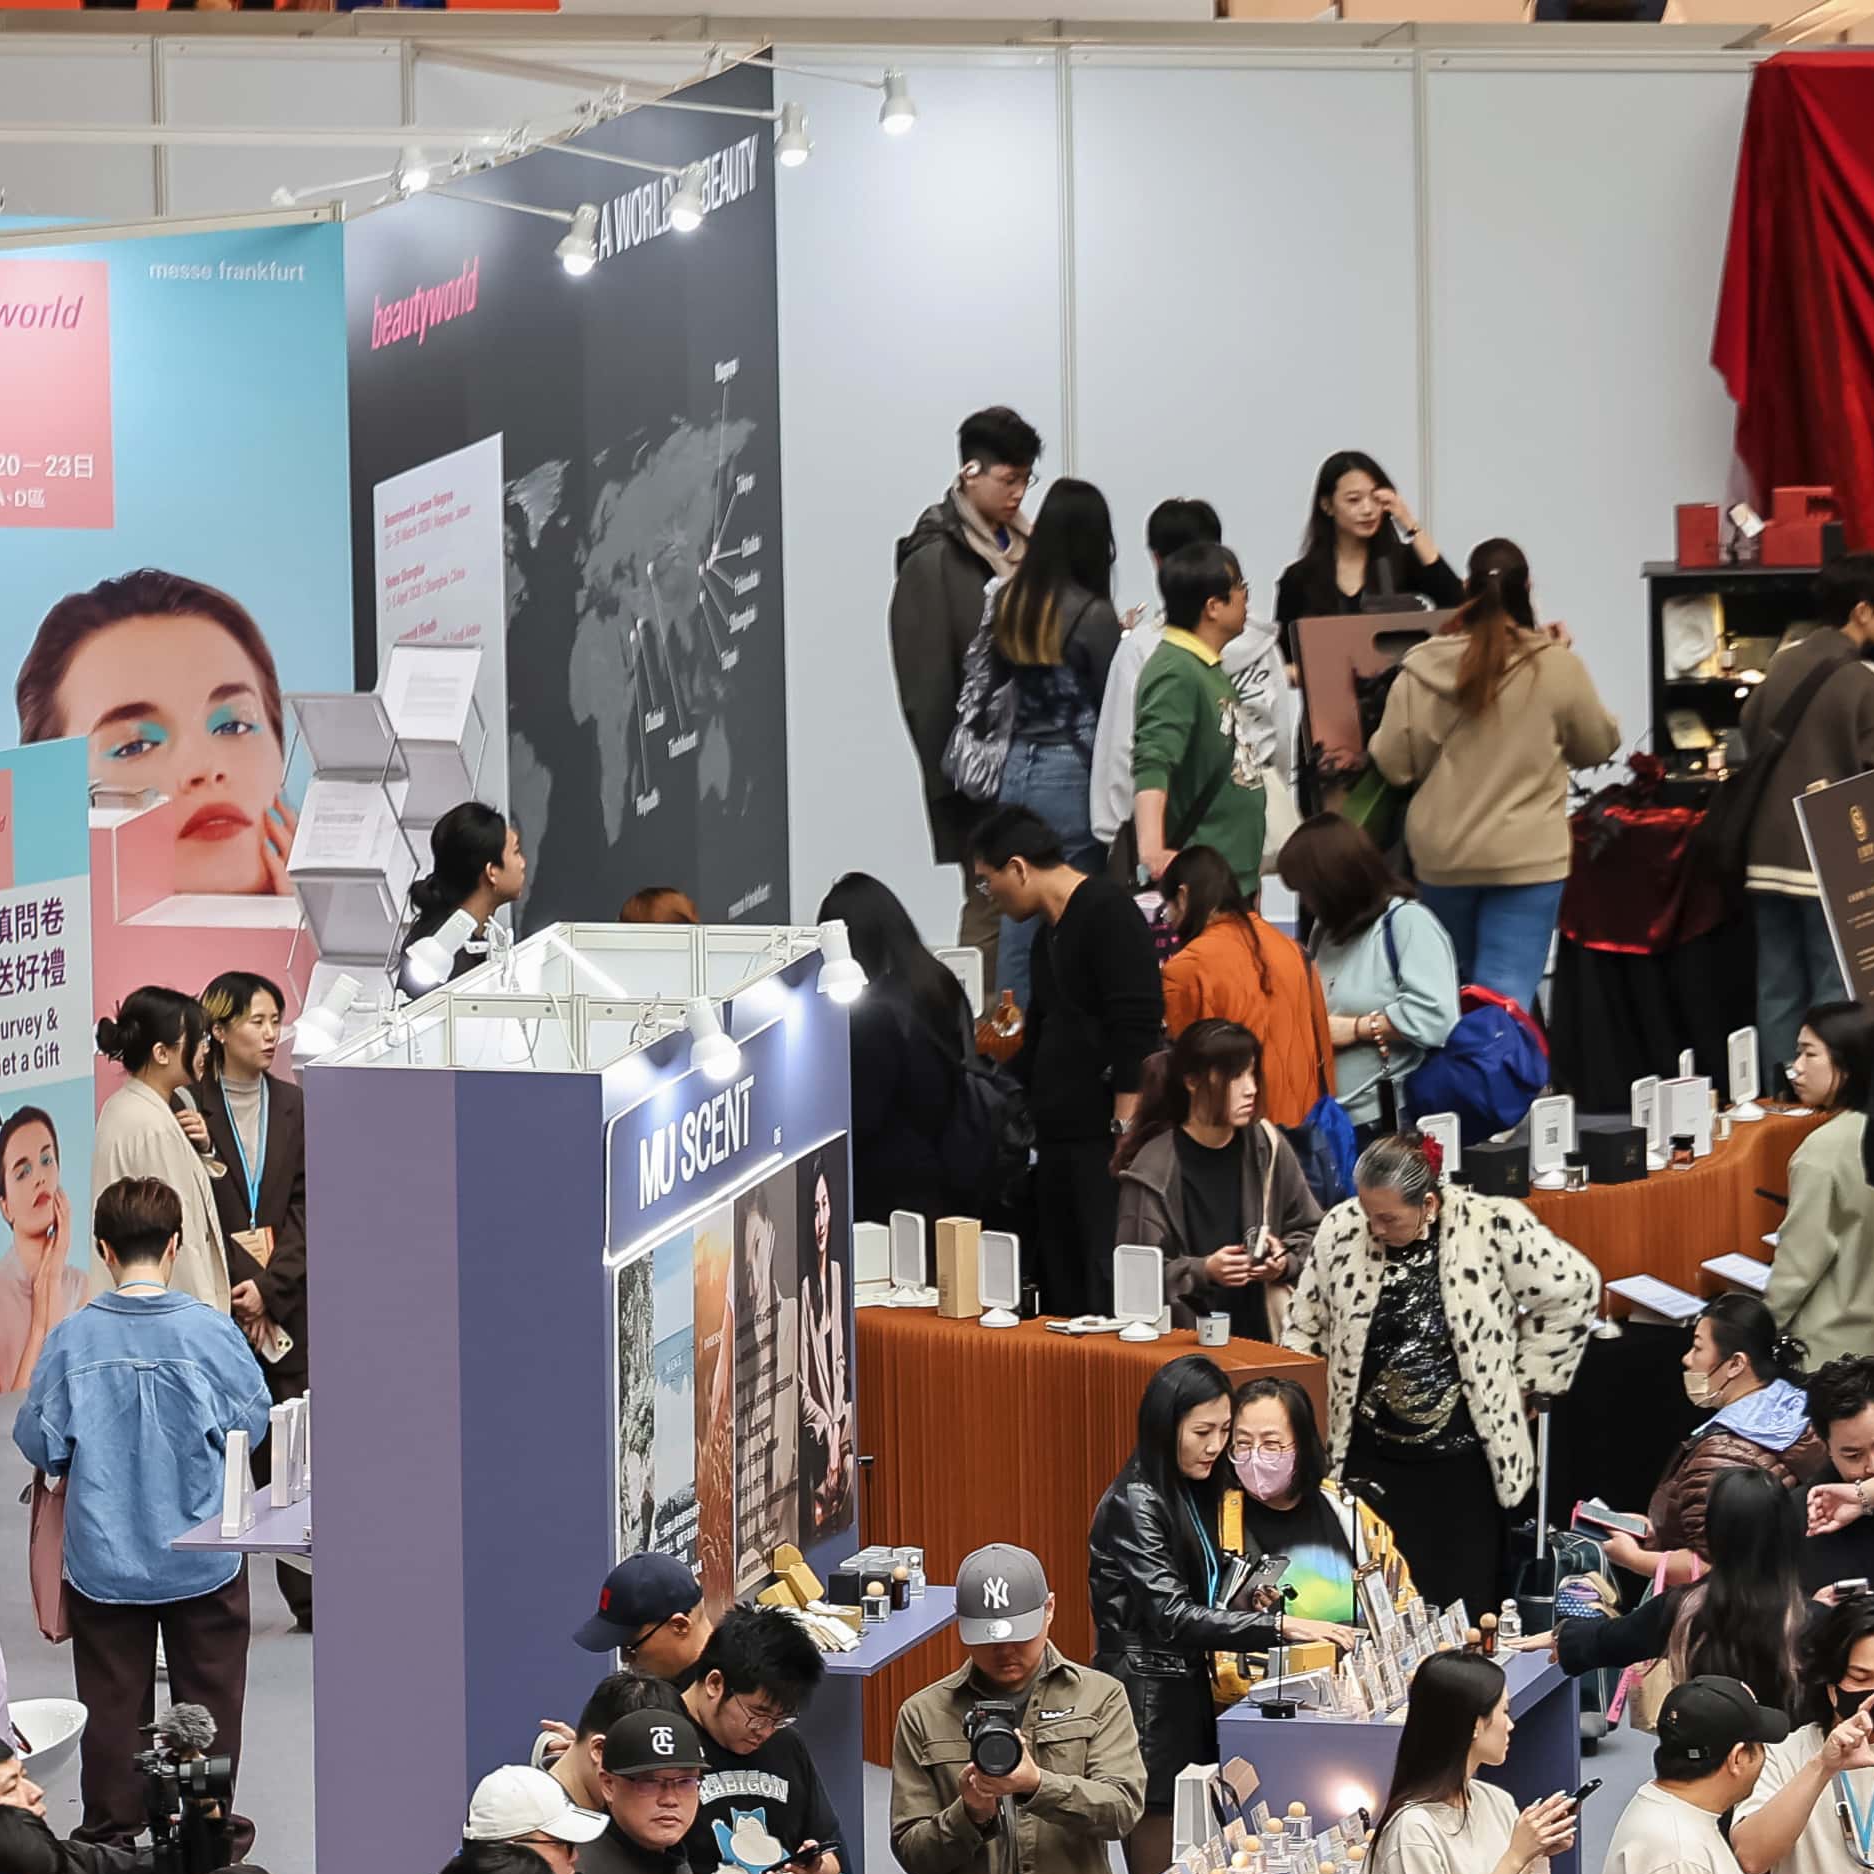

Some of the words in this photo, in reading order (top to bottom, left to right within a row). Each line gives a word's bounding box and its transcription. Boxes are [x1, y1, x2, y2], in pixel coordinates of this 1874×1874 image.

[598, 202, 613, 262] A
[614, 175, 673, 254] WORLD
[149, 262, 213, 282] messe
[219, 259, 305, 282] frankfurt
[370, 256, 481, 351] beautyworld
[46, 1007, 59, 1031] &
[32, 1042, 62, 1069] Gift
[639, 1118, 677, 1211] MU
[679, 1075, 755, 1182] SCENT
